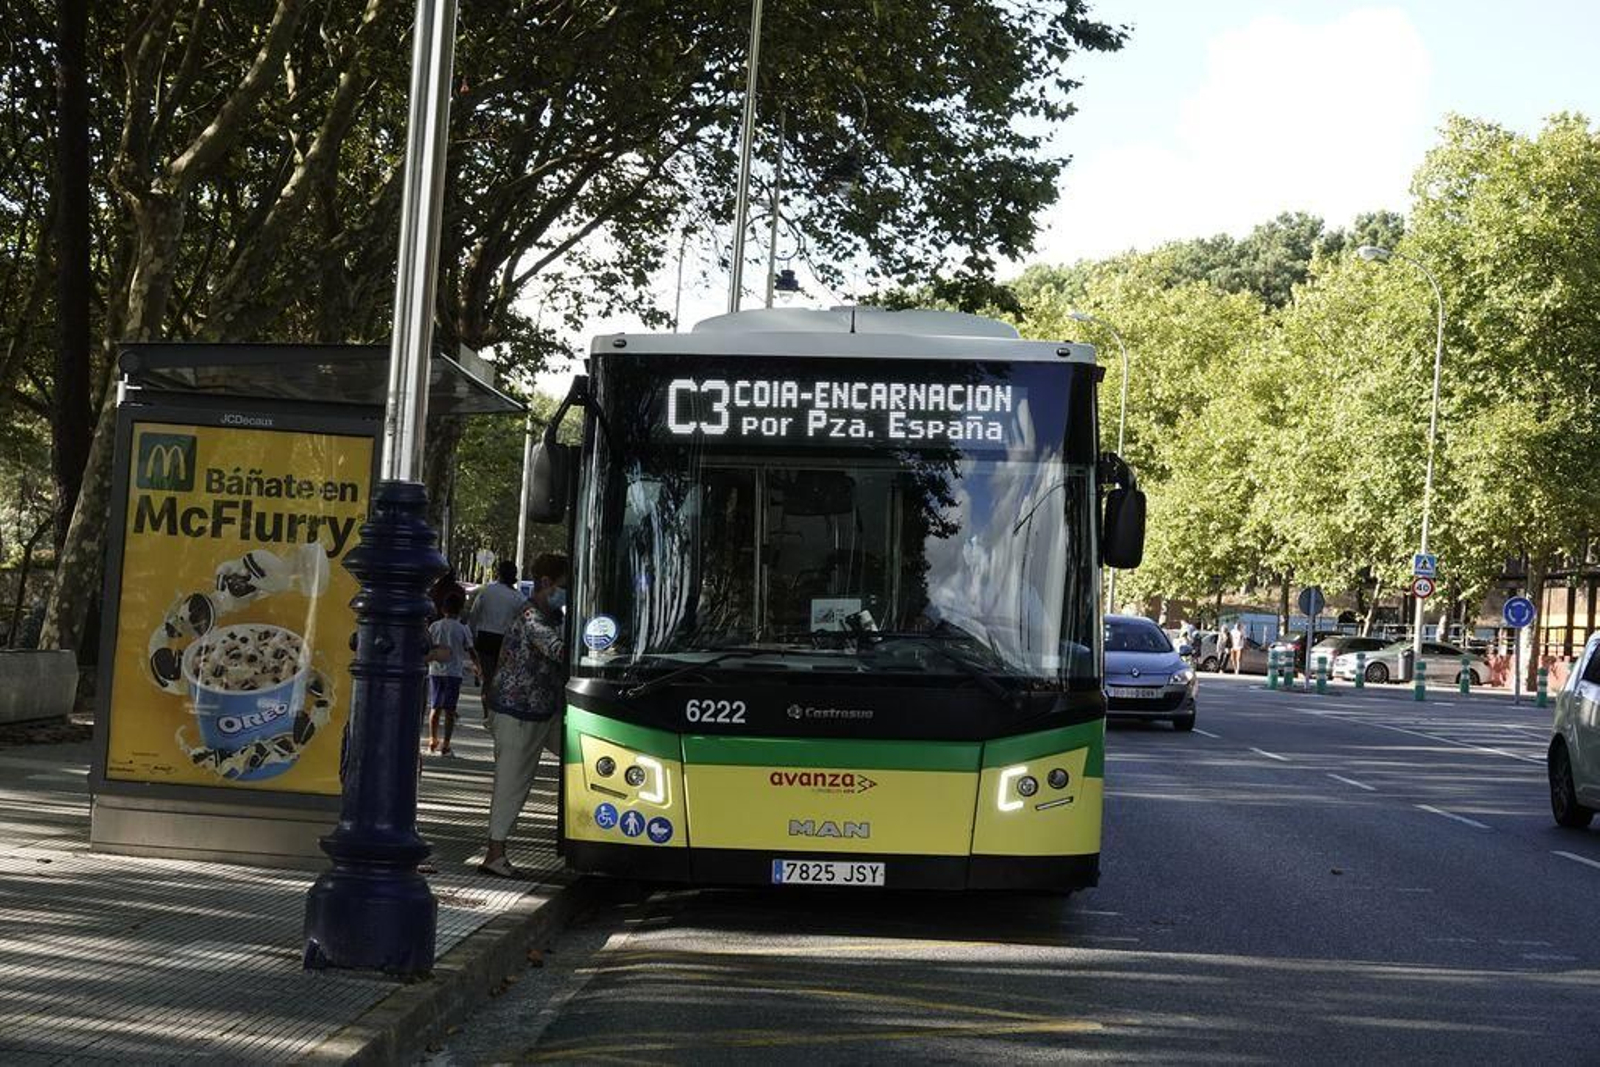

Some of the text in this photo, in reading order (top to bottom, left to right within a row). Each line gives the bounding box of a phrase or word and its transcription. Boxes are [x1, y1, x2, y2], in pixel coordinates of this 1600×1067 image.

[668, 379, 730, 434] C3
[734, 381, 1012, 412] COIA-ENCARNACION
[221, 414, 273, 426] JCDecaux
[742, 410, 1003, 440] por Pza. España
[205, 467, 358, 503] Báñate en
[1416, 583, 1430, 592] 40
[217, 702, 289, 734] OREO
[686, 699, 746, 723] 6222
[769, 771, 855, 787] avanza
[789, 819, 871, 839] MAN
[786, 862, 880, 883] 7825 JSY
